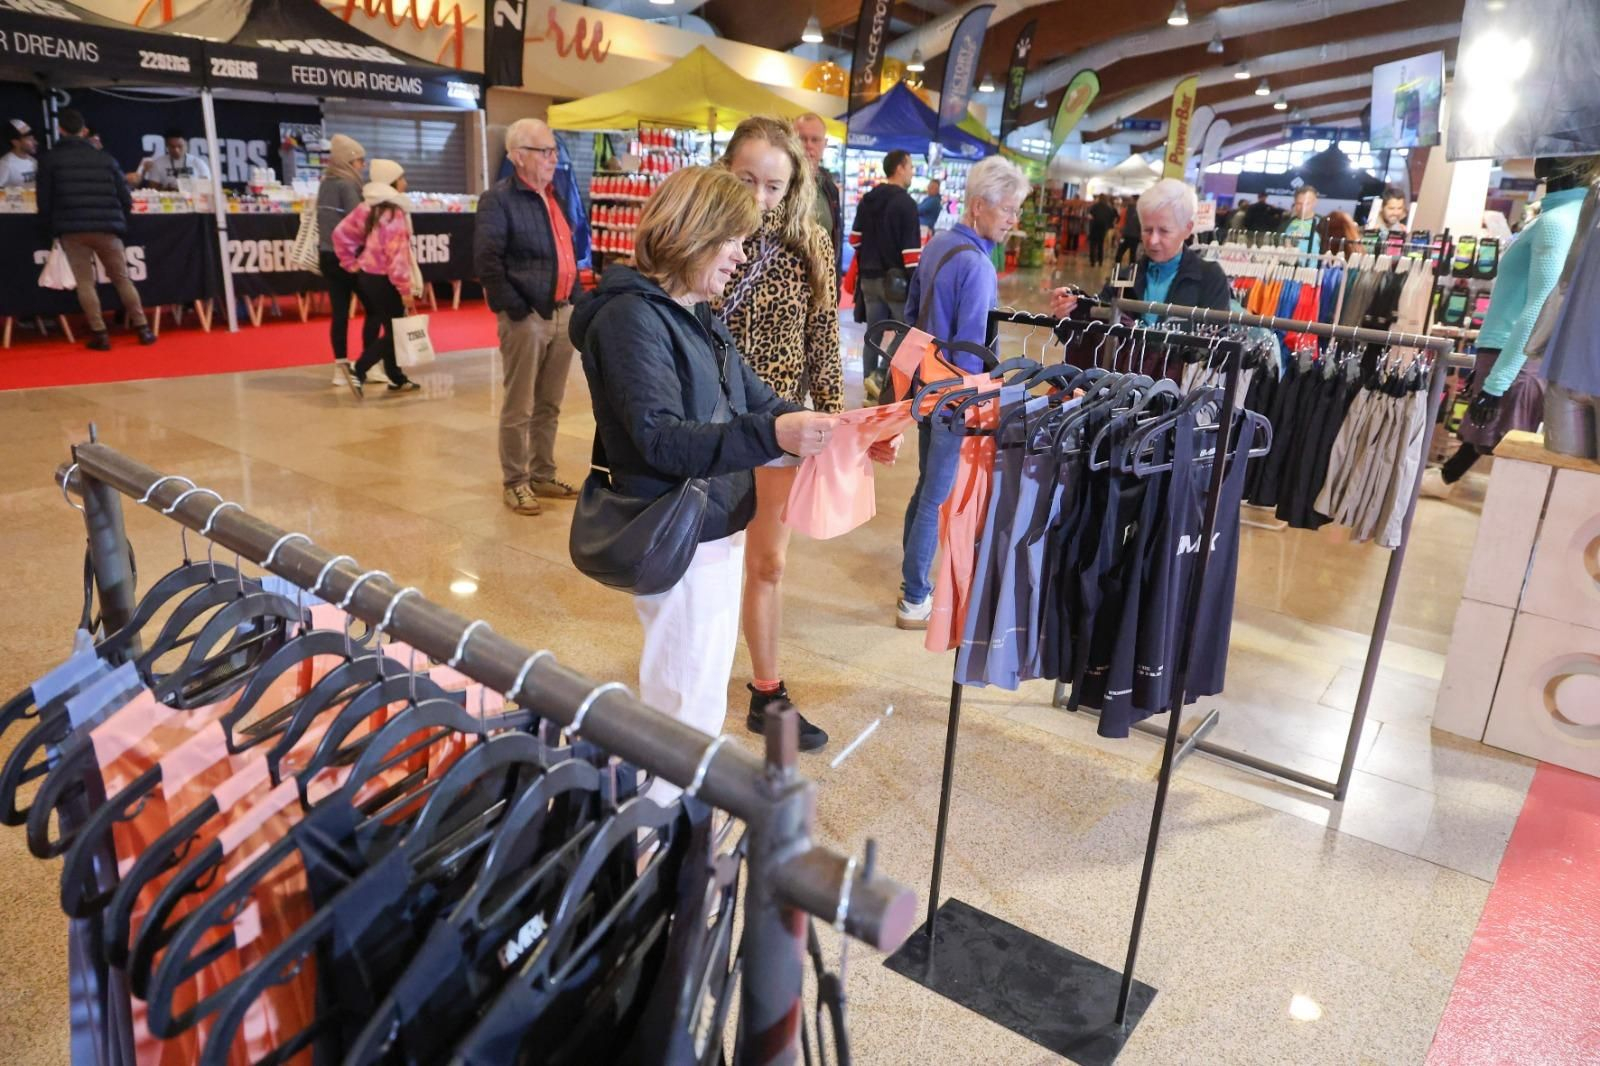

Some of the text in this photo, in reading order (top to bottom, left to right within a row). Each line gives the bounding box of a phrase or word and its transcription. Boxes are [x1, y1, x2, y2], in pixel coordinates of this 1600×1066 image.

[12, 31, 100, 64] DREAMS
[290, 64, 328, 87] FEED
[329, 67, 368, 90] YOUR
[369, 72, 424, 96] DREAMS
